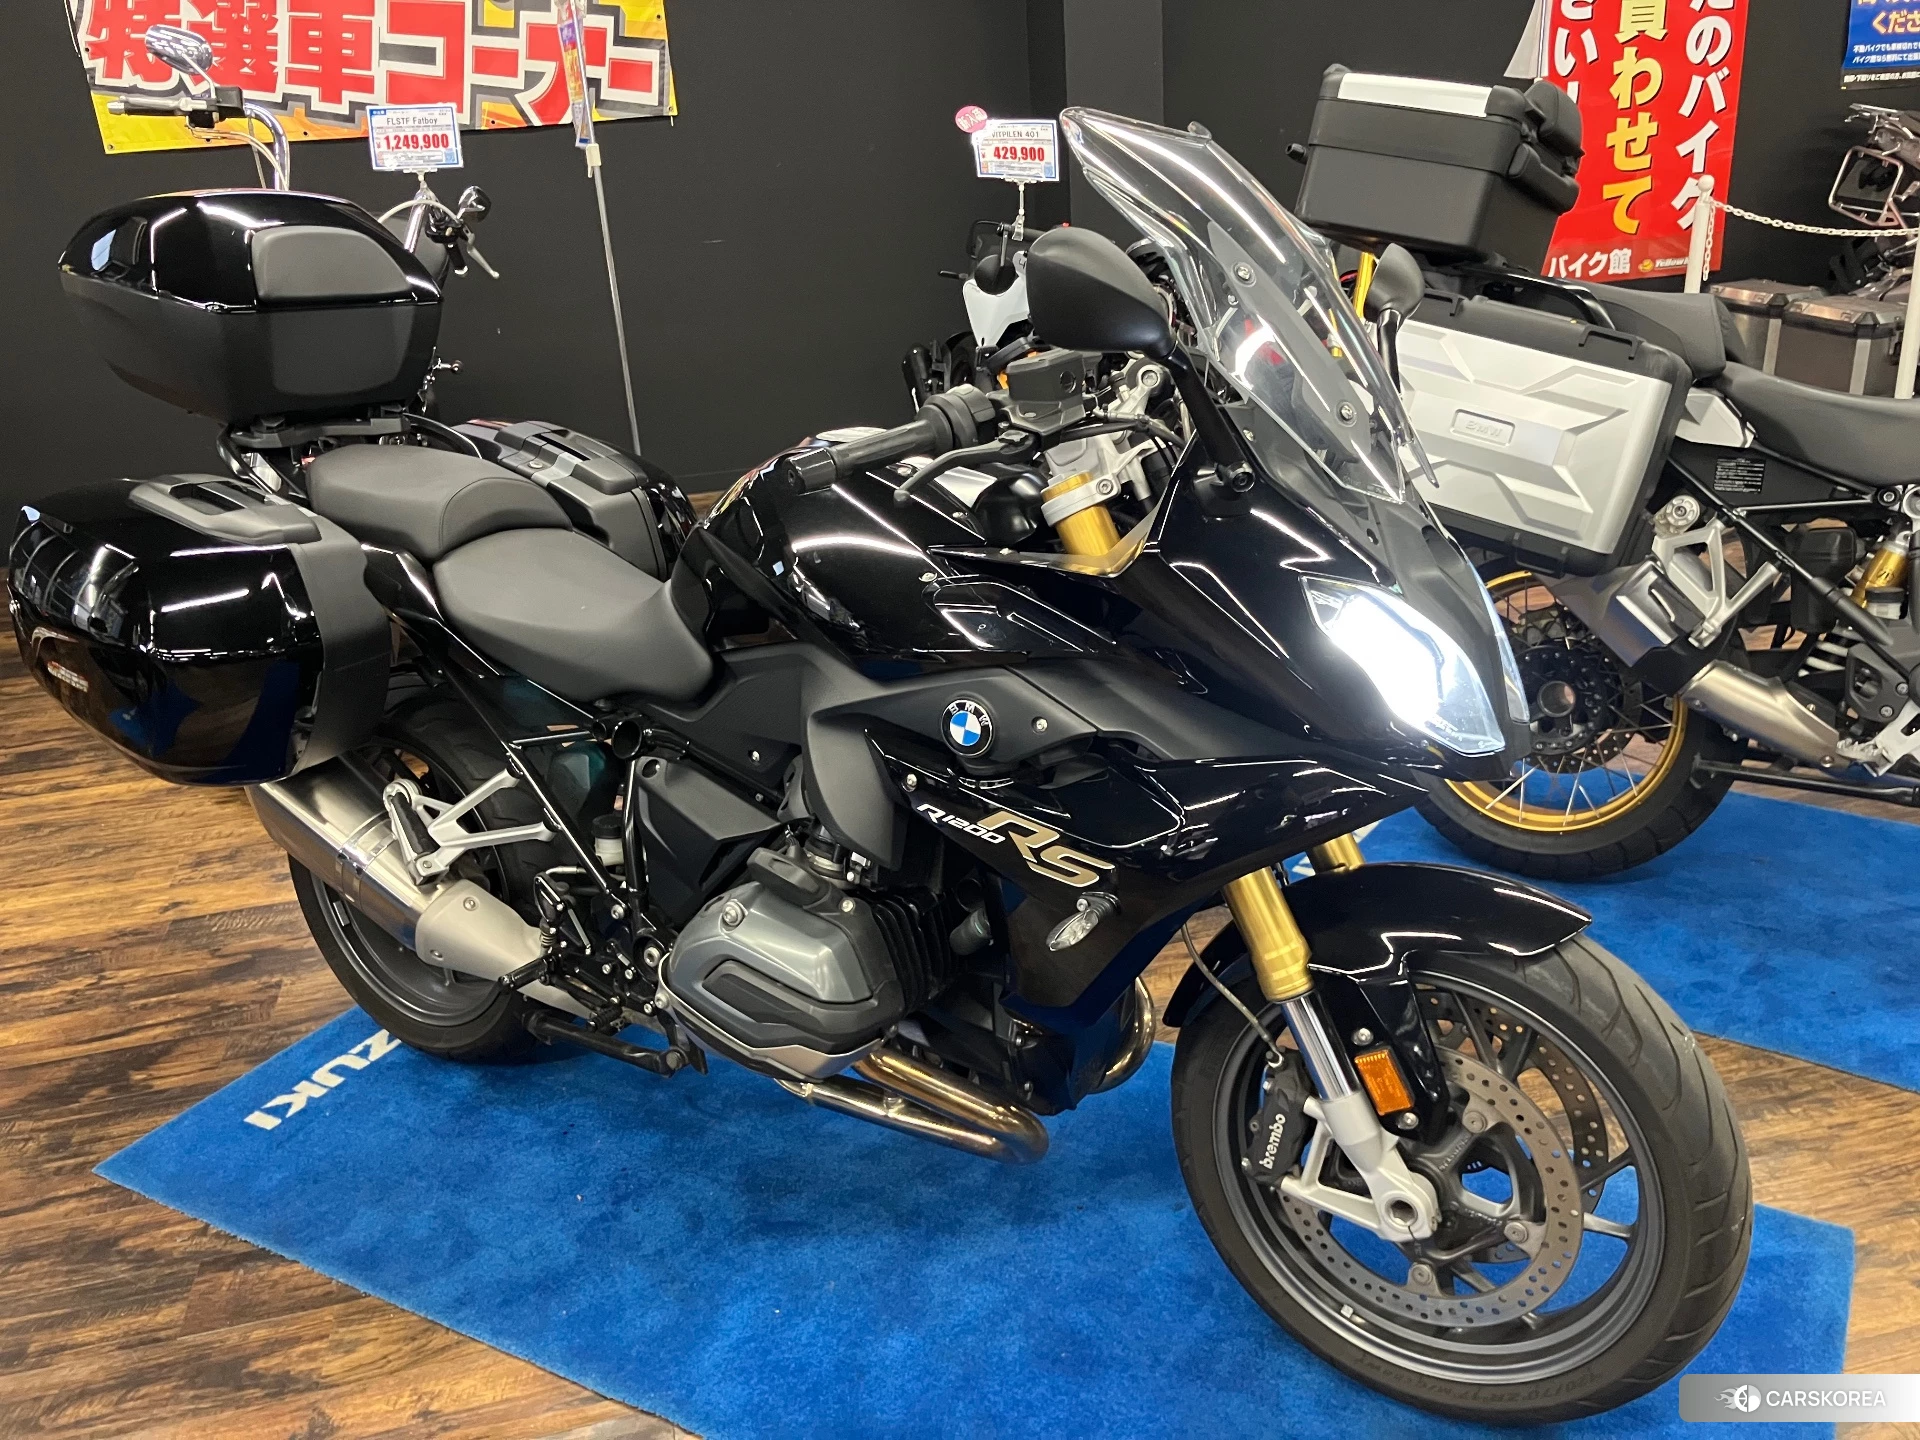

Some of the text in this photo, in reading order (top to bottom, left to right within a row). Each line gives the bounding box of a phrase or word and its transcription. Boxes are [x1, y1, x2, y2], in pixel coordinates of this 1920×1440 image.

[386, 116, 438, 126] FLSTF Fatboy
[384, 133, 449, 152] 1,249,900
[1025, 130, 1039, 138] 401
[993, 146, 1045, 161] 429,900
[1547, 248, 1632, 278] バイク館
[976, 811, 1116, 888] RS
[1259, 1113, 1286, 1170] brembo
